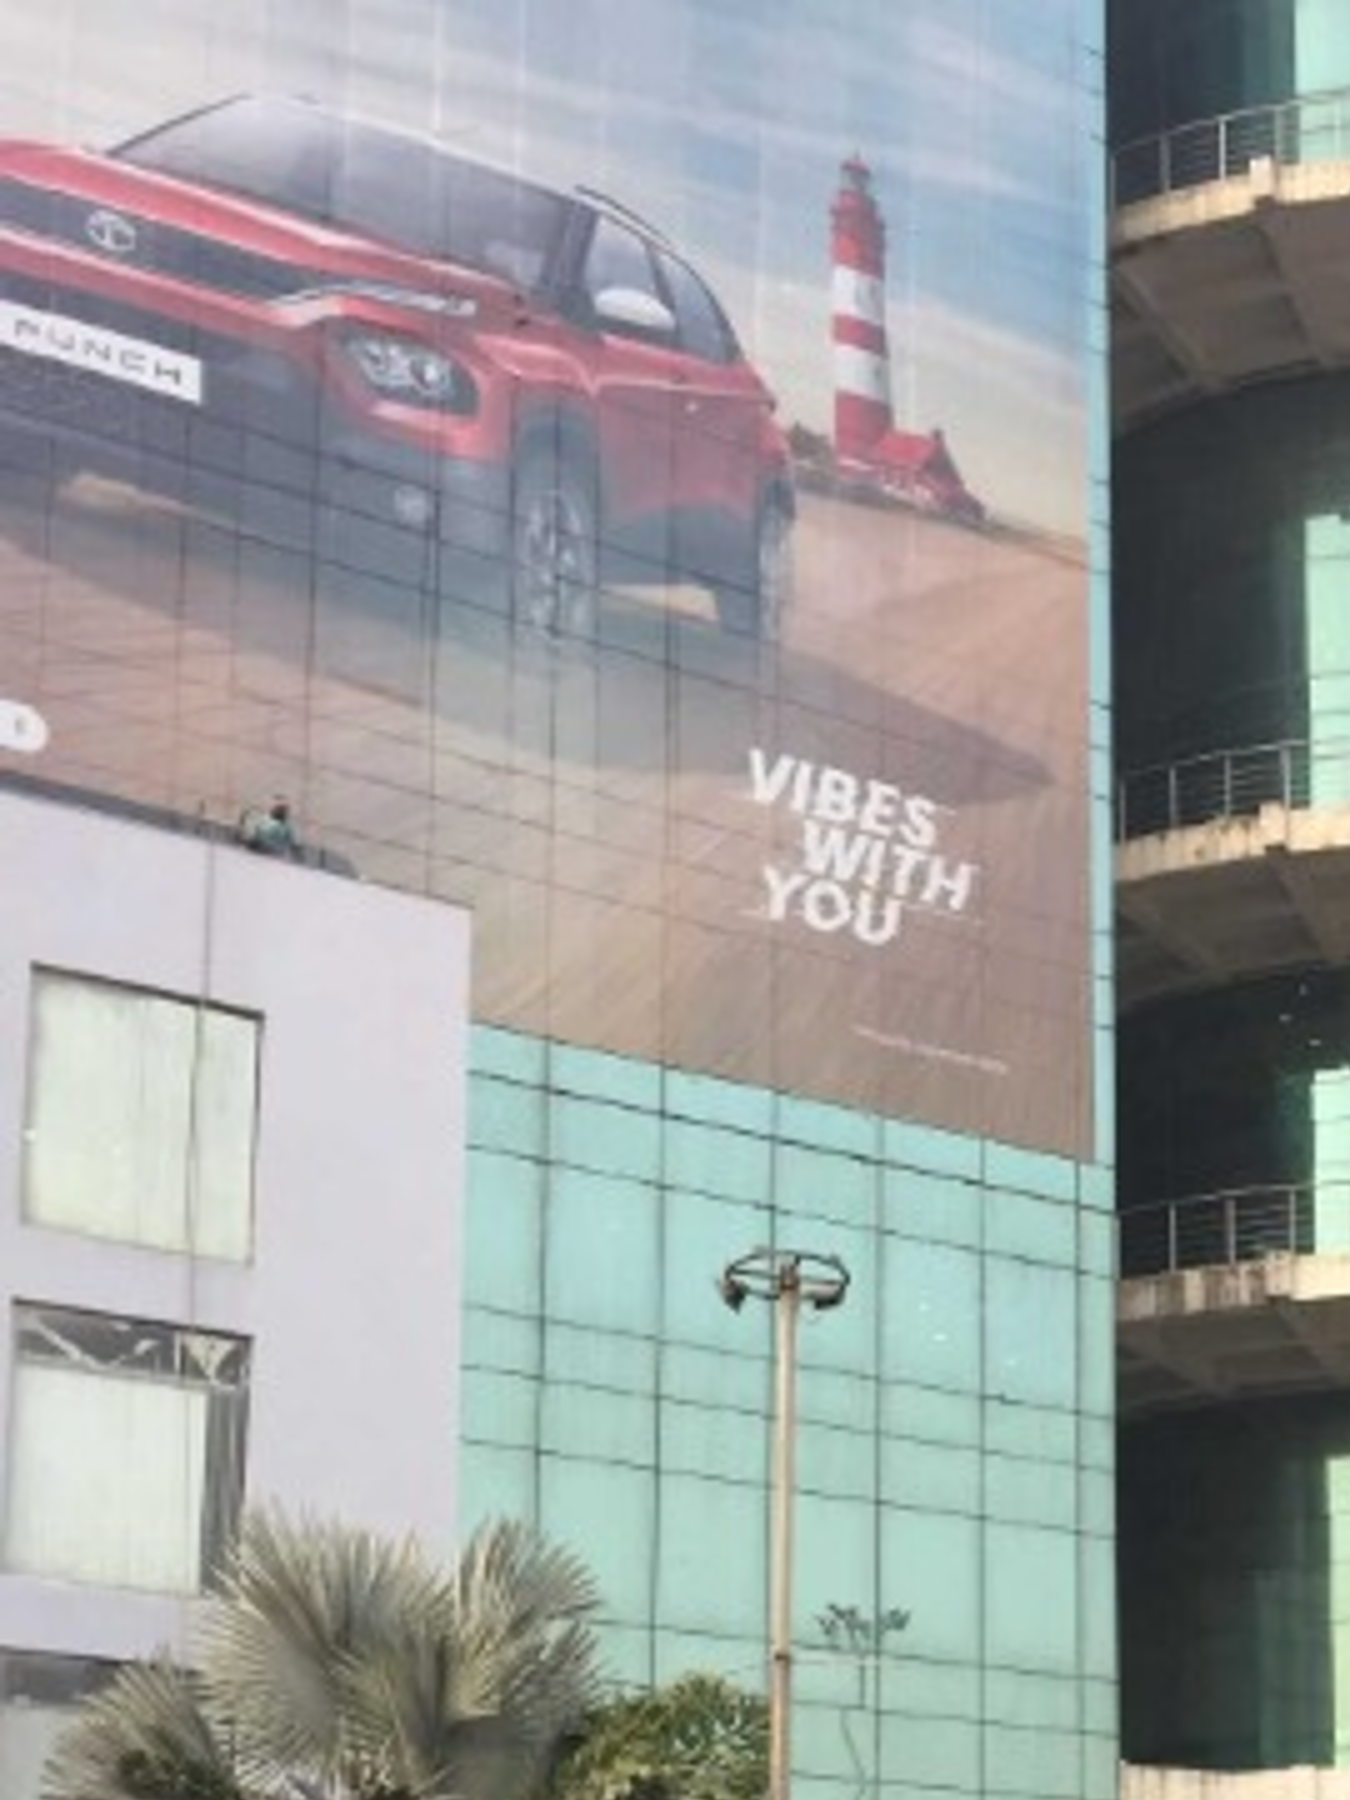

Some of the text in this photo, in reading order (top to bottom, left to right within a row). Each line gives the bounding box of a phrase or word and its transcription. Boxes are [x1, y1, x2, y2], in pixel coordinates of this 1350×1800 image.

[14, 318, 182, 387] PUNCH
[748, 746, 938, 848] VIBES
[763, 863, 901, 947] YOU
[802, 819, 976, 912] WITH
